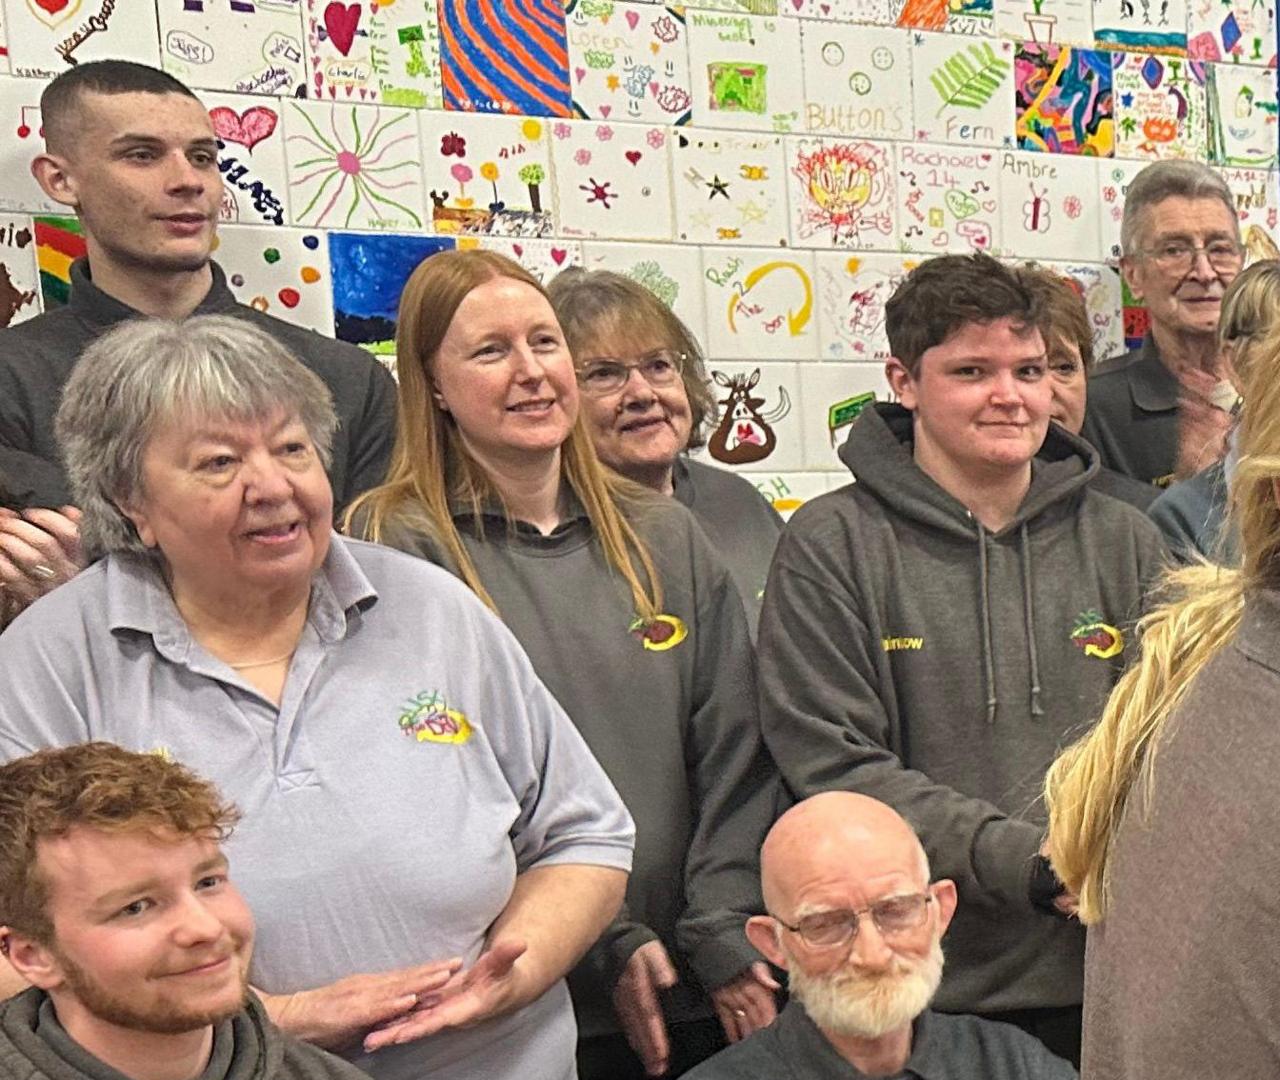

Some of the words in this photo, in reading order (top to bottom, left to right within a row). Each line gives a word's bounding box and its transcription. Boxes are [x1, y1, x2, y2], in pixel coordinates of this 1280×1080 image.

[806, 104, 904, 133] Button's
[945, 117, 995, 140] Fern
[926, 170, 960, 188] 14
[1002, 153, 1058, 179] Ambre
[705, 256, 744, 287] Rush
[732, 281, 751, 297] 2
